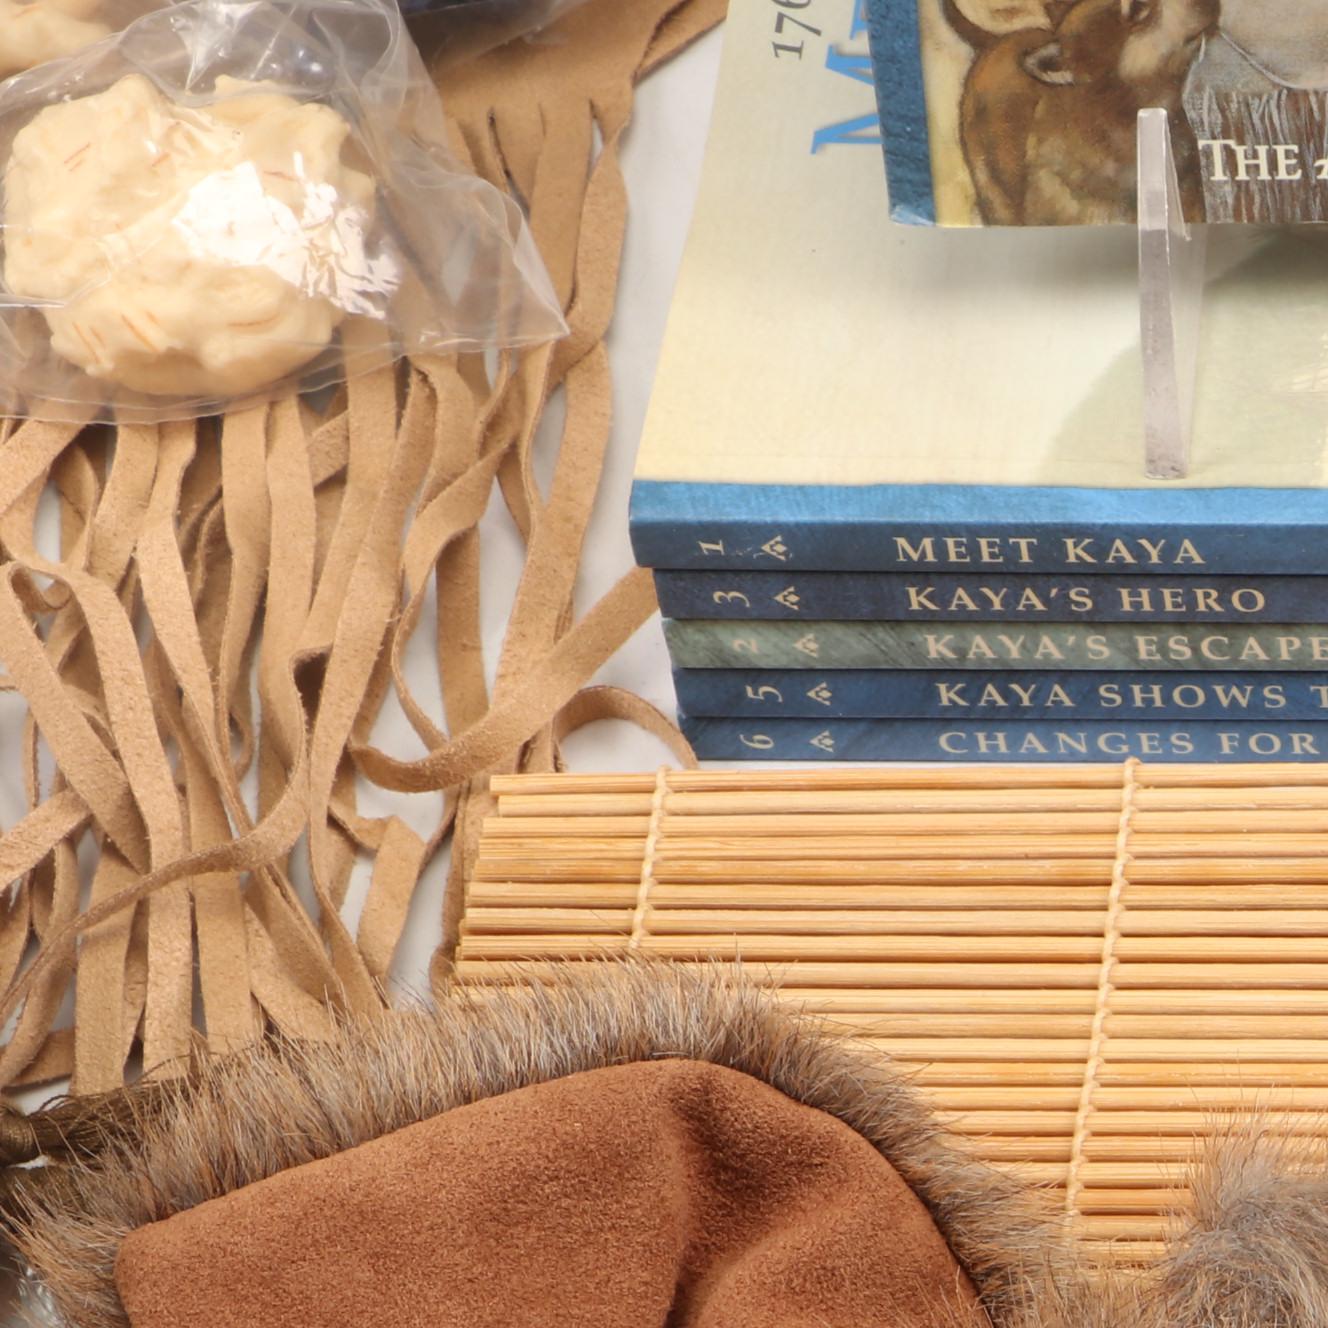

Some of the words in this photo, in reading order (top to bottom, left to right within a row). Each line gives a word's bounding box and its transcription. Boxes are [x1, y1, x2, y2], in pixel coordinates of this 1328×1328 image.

[1198, 138, 1303, 181] THE
[893, 536, 1038, 563] MEET
[1064, 537, 1206, 565] KAYA
[713, 589, 750, 608] 3
[906, 586, 1095, 612] KAYA'S
[1118, 587, 1267, 613] HERO
[732, 638, 759, 654] 2
[924, 634, 1111, 660] KAYA'S
[746, 684, 782, 703] 5
[937, 682, 1076, 708] KAYA
[1099, 684, 1287, 709] SHOWS
[739, 732, 775, 751] 6
[938, 731, 1195, 755] CHANGES
[1217, 732, 1320, 756] FOR
